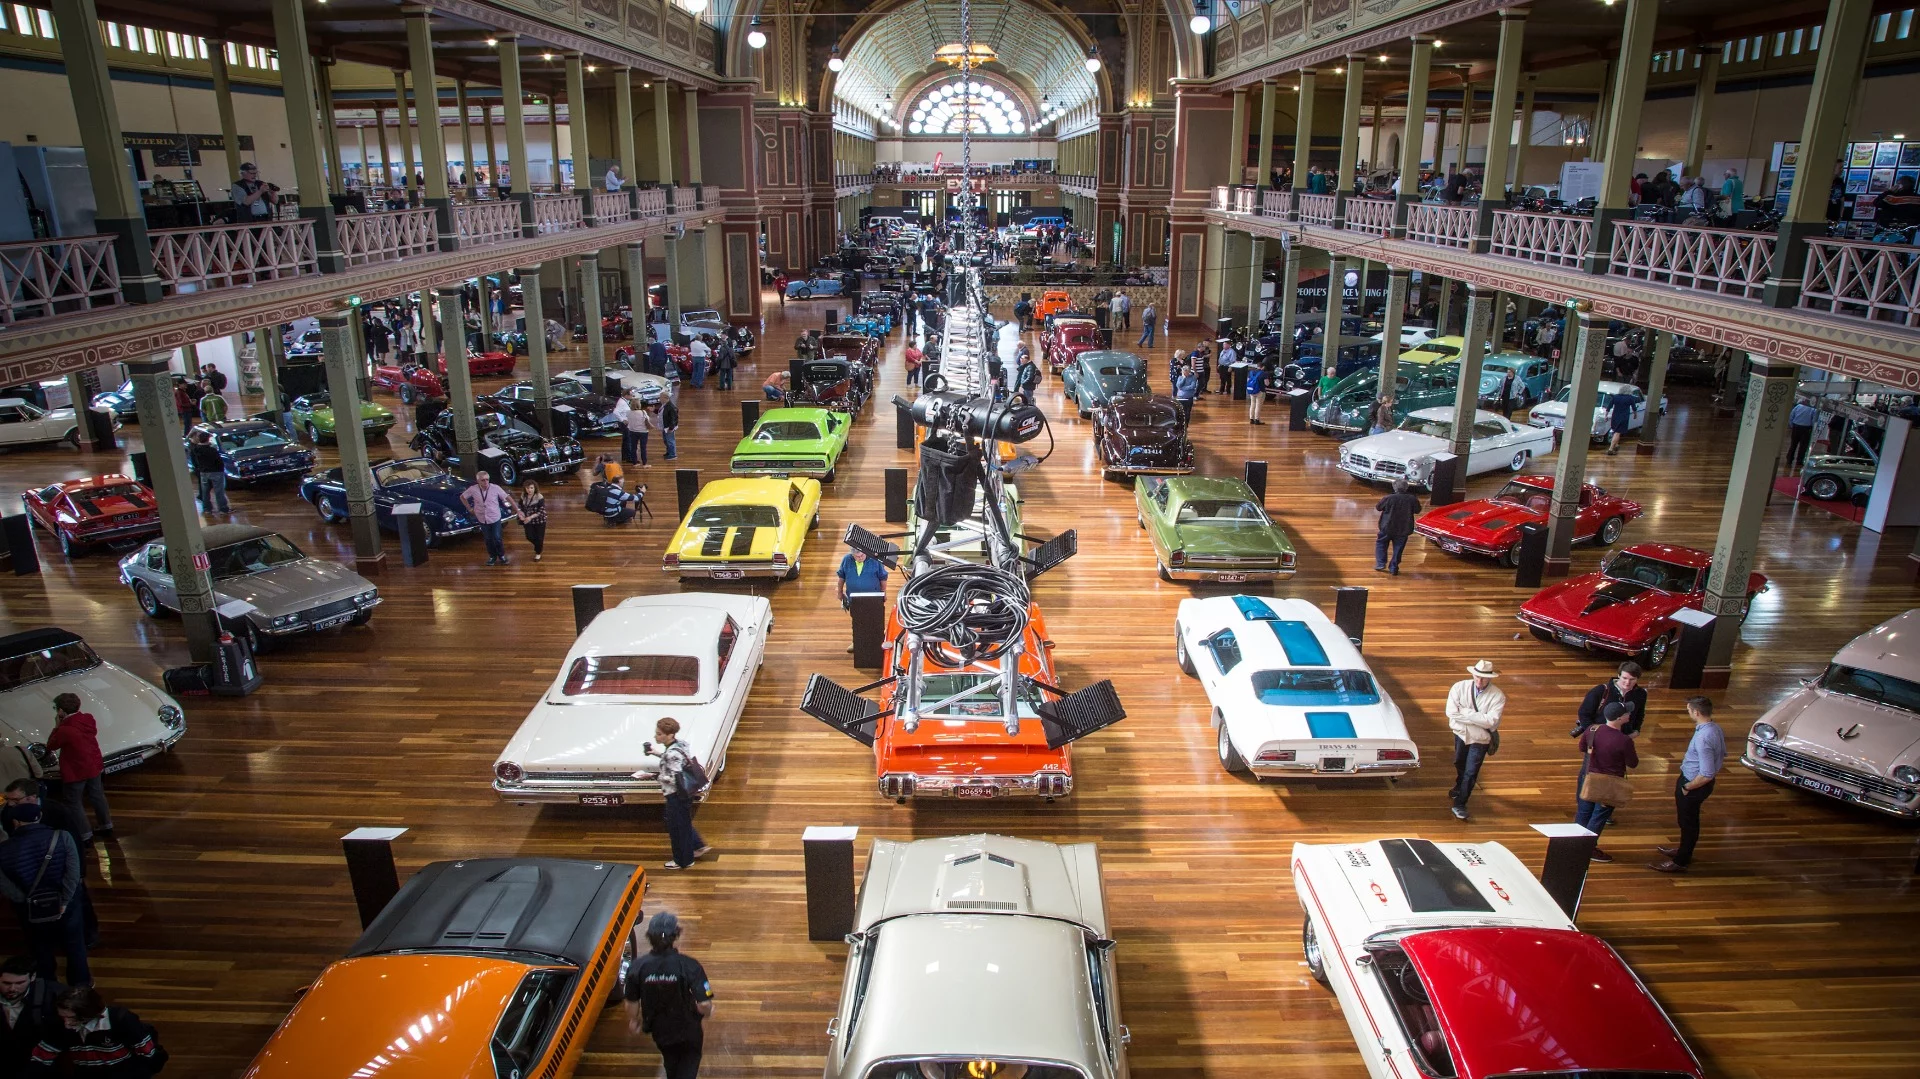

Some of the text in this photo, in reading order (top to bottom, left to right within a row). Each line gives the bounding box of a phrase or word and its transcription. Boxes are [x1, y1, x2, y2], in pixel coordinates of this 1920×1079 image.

[123, 137, 175, 146] PIZZERIA
[946, 179, 978, 190] EXT
[1296, 287, 1327, 297] PEOPLE'S
